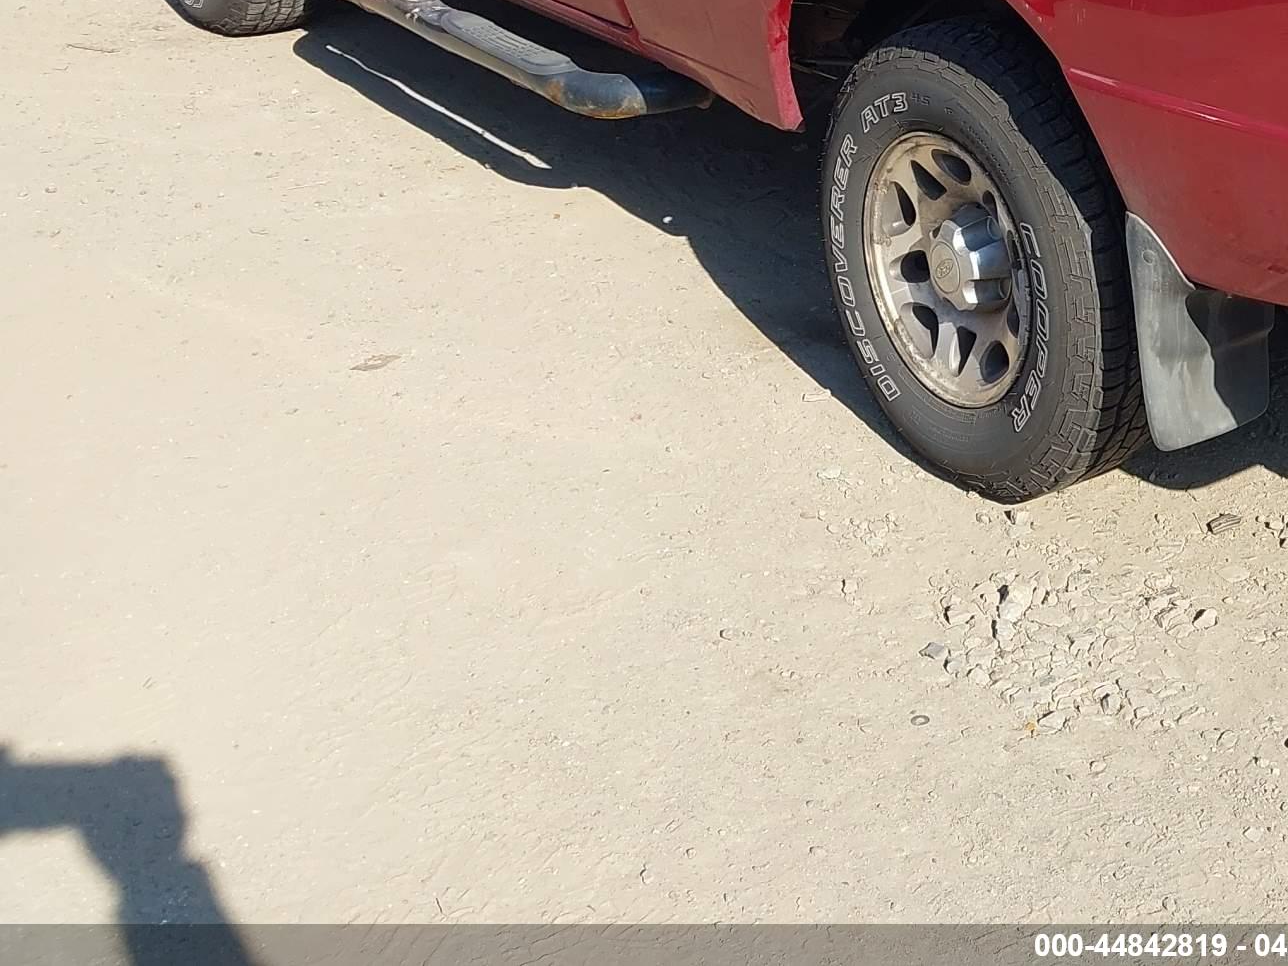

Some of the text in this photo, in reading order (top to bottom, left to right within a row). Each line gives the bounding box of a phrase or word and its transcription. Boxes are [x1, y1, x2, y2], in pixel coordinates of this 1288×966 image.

[860, 92, 909, 133] AT3
[829, 133, 902, 402] DISCOVERER
[1011, 222, 1050, 433] COOPER
